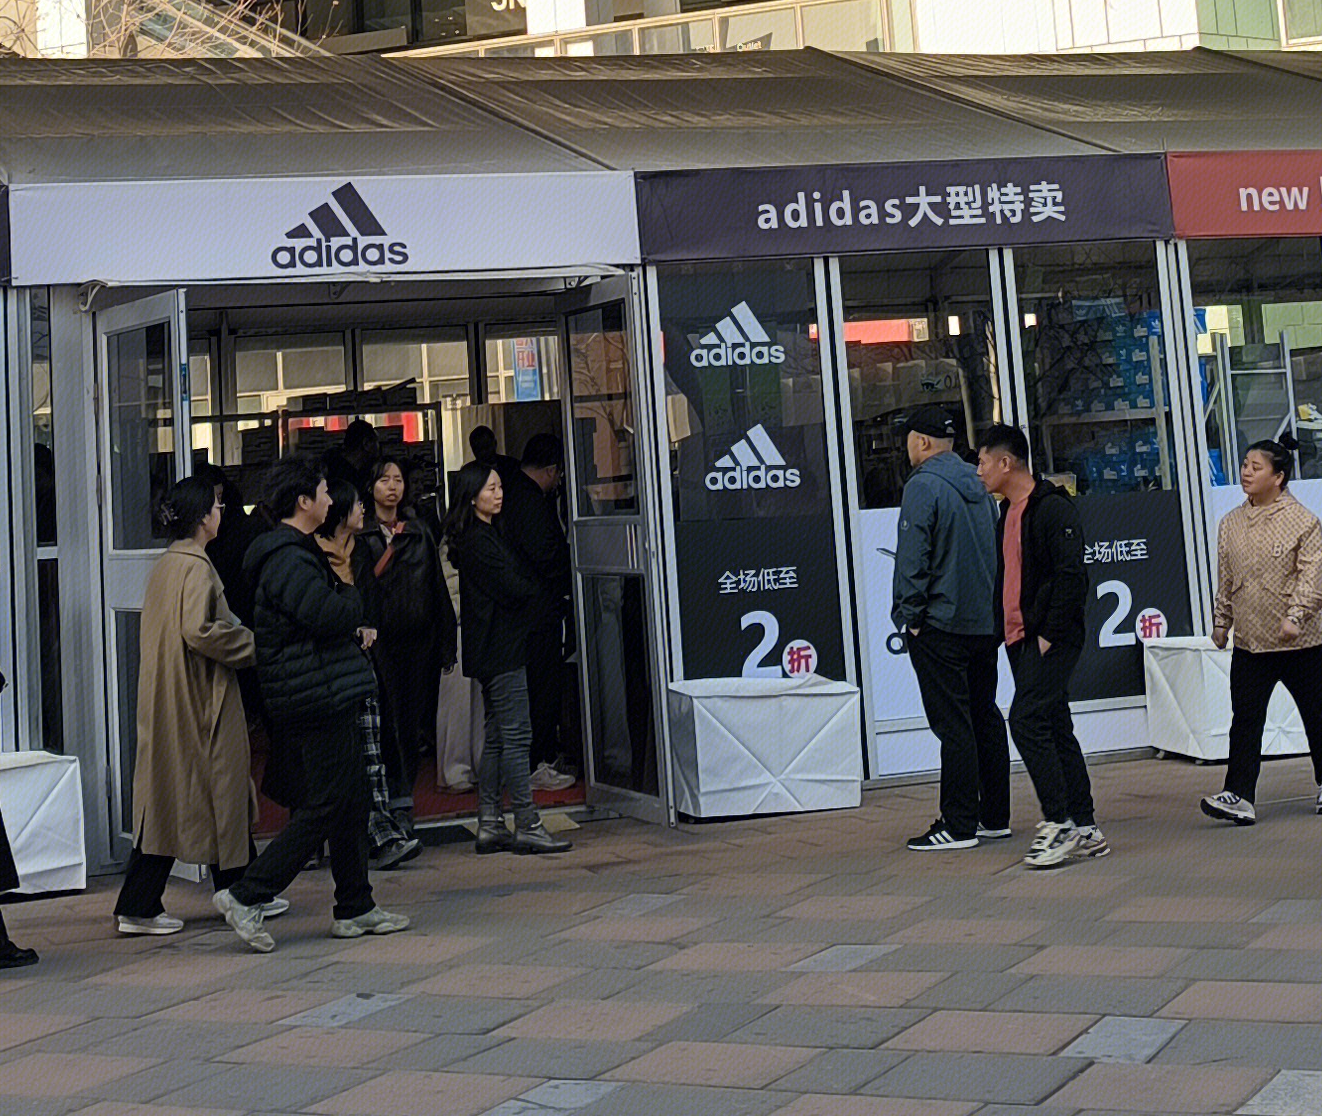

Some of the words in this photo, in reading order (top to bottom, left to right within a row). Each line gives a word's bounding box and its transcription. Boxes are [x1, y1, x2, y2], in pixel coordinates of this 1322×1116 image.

[757, 180, 1066, 229] adidas大型特卖
[1239, 185, 1309, 211] new
[271, 237, 409, 270] adidas
[690, 342, 786, 367] adidas
[705, 465, 801, 490] adidas
[718, 566, 799, 593] 全场低至
